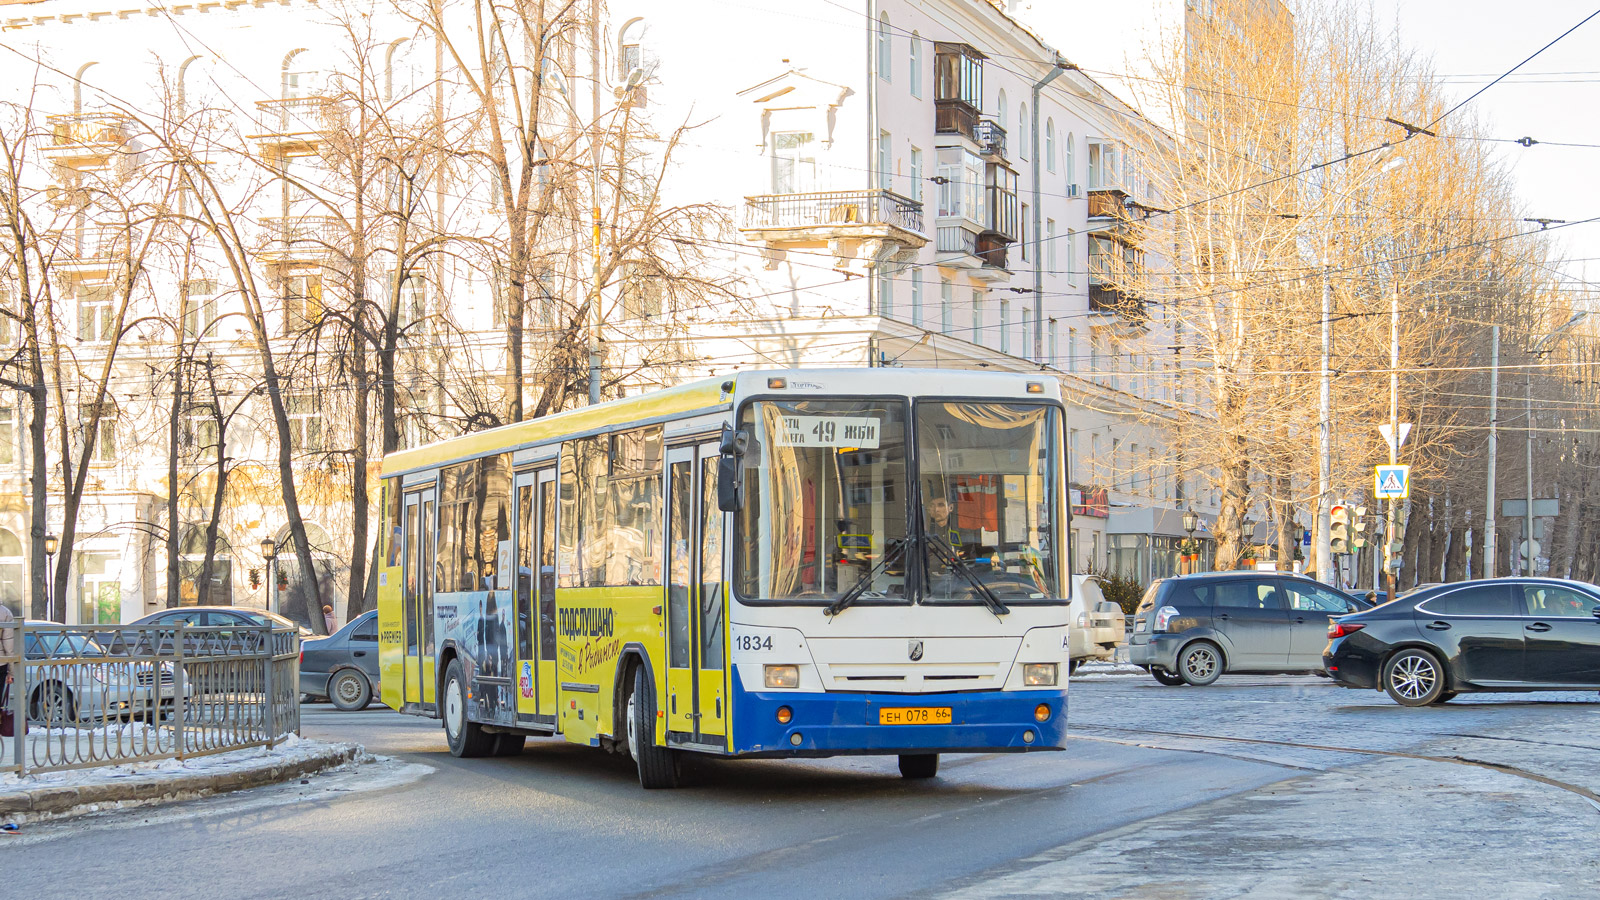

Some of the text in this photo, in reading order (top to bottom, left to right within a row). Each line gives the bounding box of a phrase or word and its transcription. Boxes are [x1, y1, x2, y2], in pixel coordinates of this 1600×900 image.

[812, 420, 875, 443] 49 ЖБИ
[558, 607, 614, 641] ПОДСЛУШАНО
[735, 635, 774, 651] 1834
[906, 709, 928, 722] 078
[935, 708, 948, 719] 66
